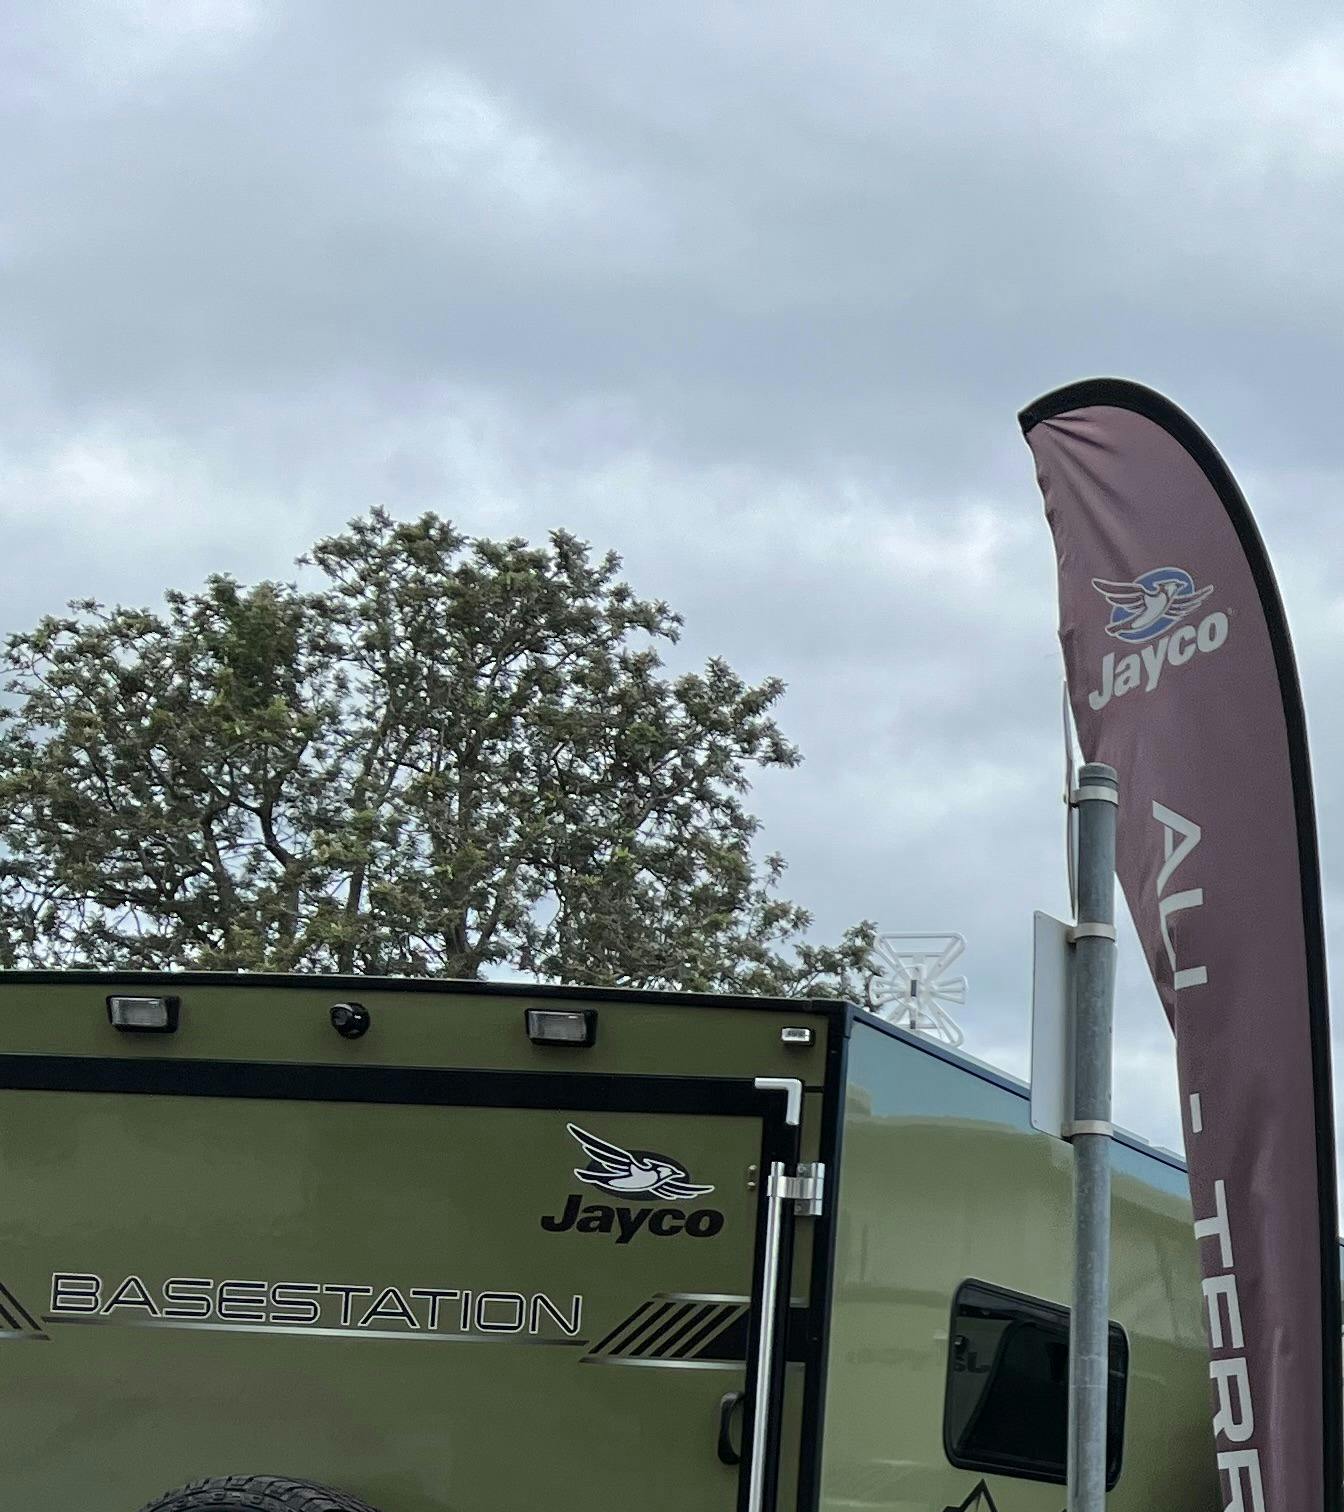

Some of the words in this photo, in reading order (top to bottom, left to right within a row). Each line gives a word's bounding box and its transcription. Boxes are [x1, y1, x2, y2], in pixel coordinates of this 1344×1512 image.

[1088, 611, 1229, 710] Jayco
[541, 1194, 725, 1244] Jayco
[50, 1272, 583, 1336] BASESTATION
